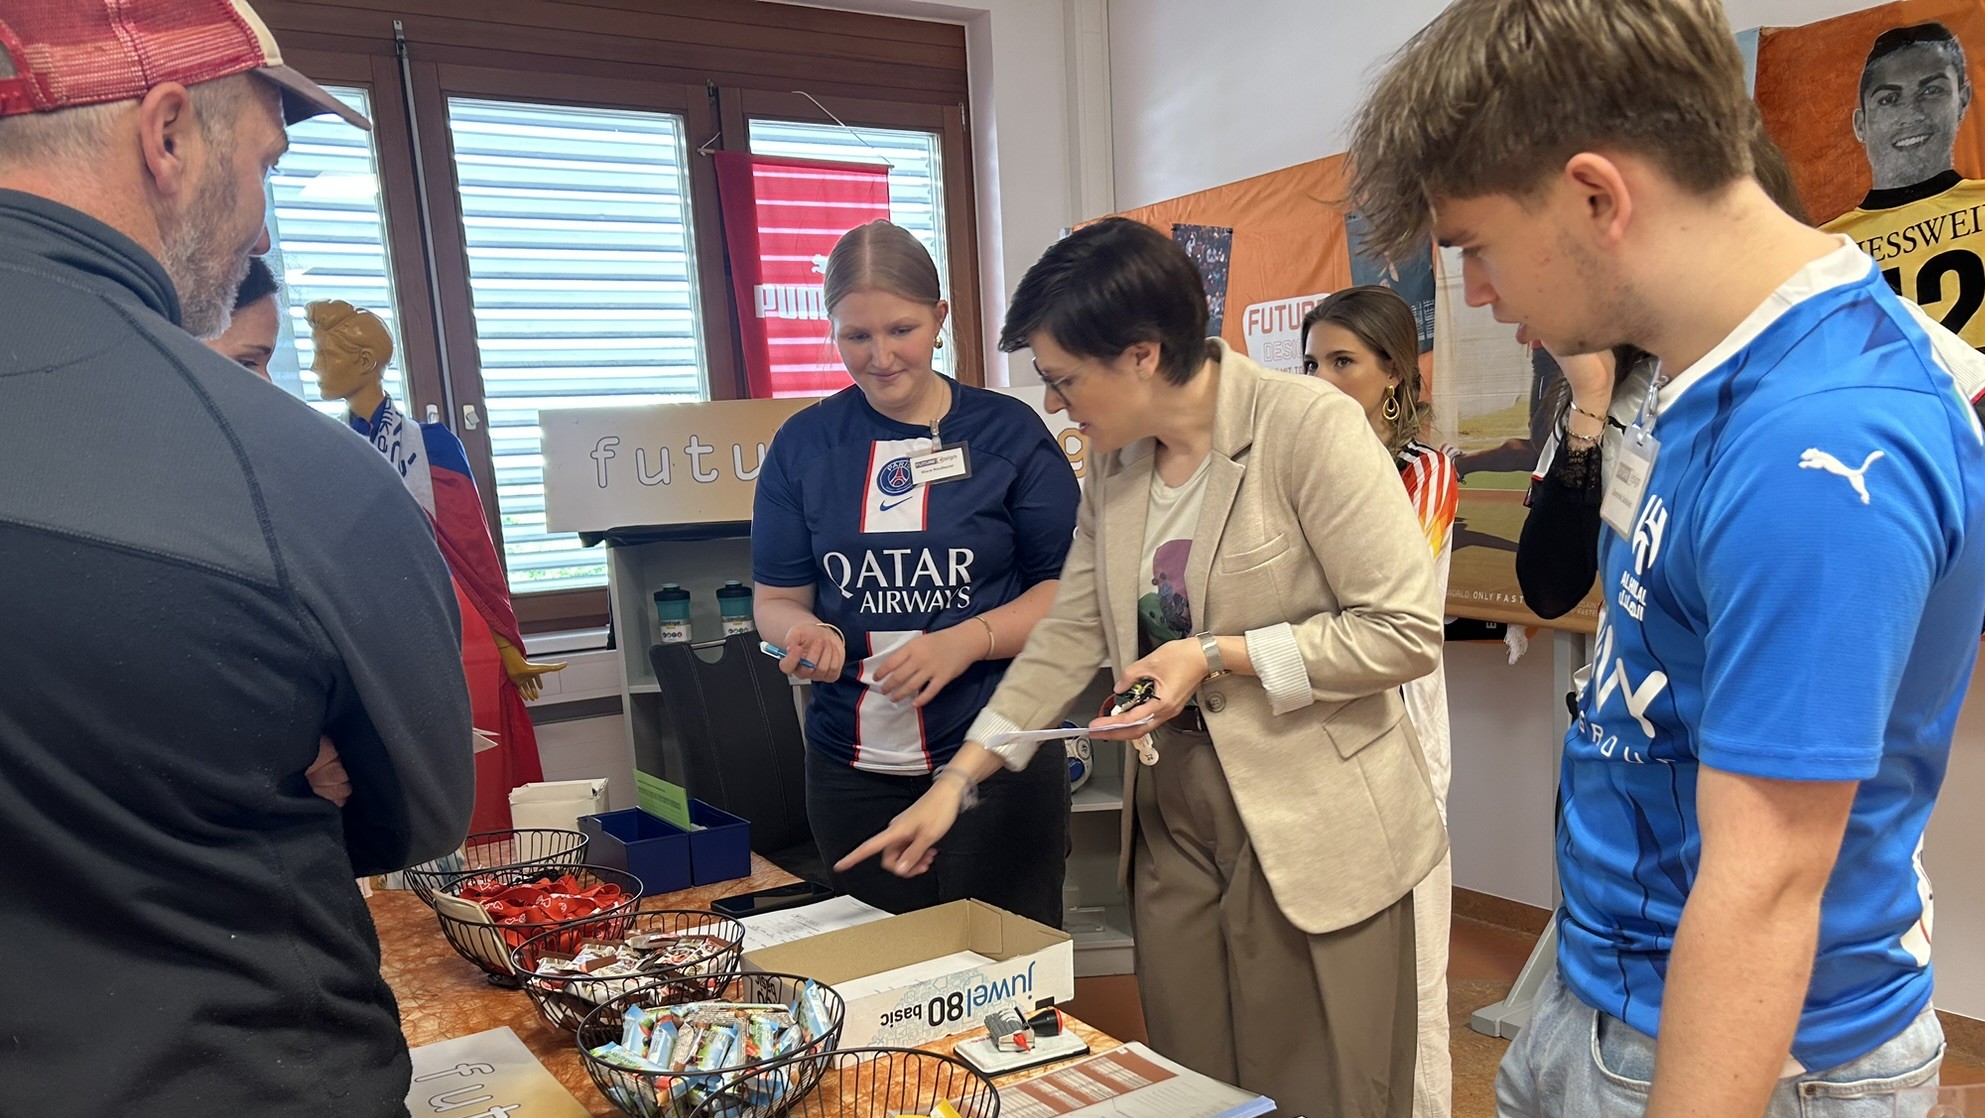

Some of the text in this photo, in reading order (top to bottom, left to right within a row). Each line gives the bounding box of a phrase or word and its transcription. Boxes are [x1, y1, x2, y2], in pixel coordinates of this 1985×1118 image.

[1856, 203, 1985, 262] ESSWEI
[754, 283, 829, 320] PUM
[1248, 301, 1316, 336] FUTU
[590, 435, 767, 488] futu
[823, 548, 974, 598] QATAR
[1473, 590, 1493, 600] ONLY
[1496, 593, 1524, 604] FAST
[860, 586, 971, 613] AIRWAYS
[880, 960, 1036, 1028] juwel 80 basic
[414, 1063, 521, 1118] fut
